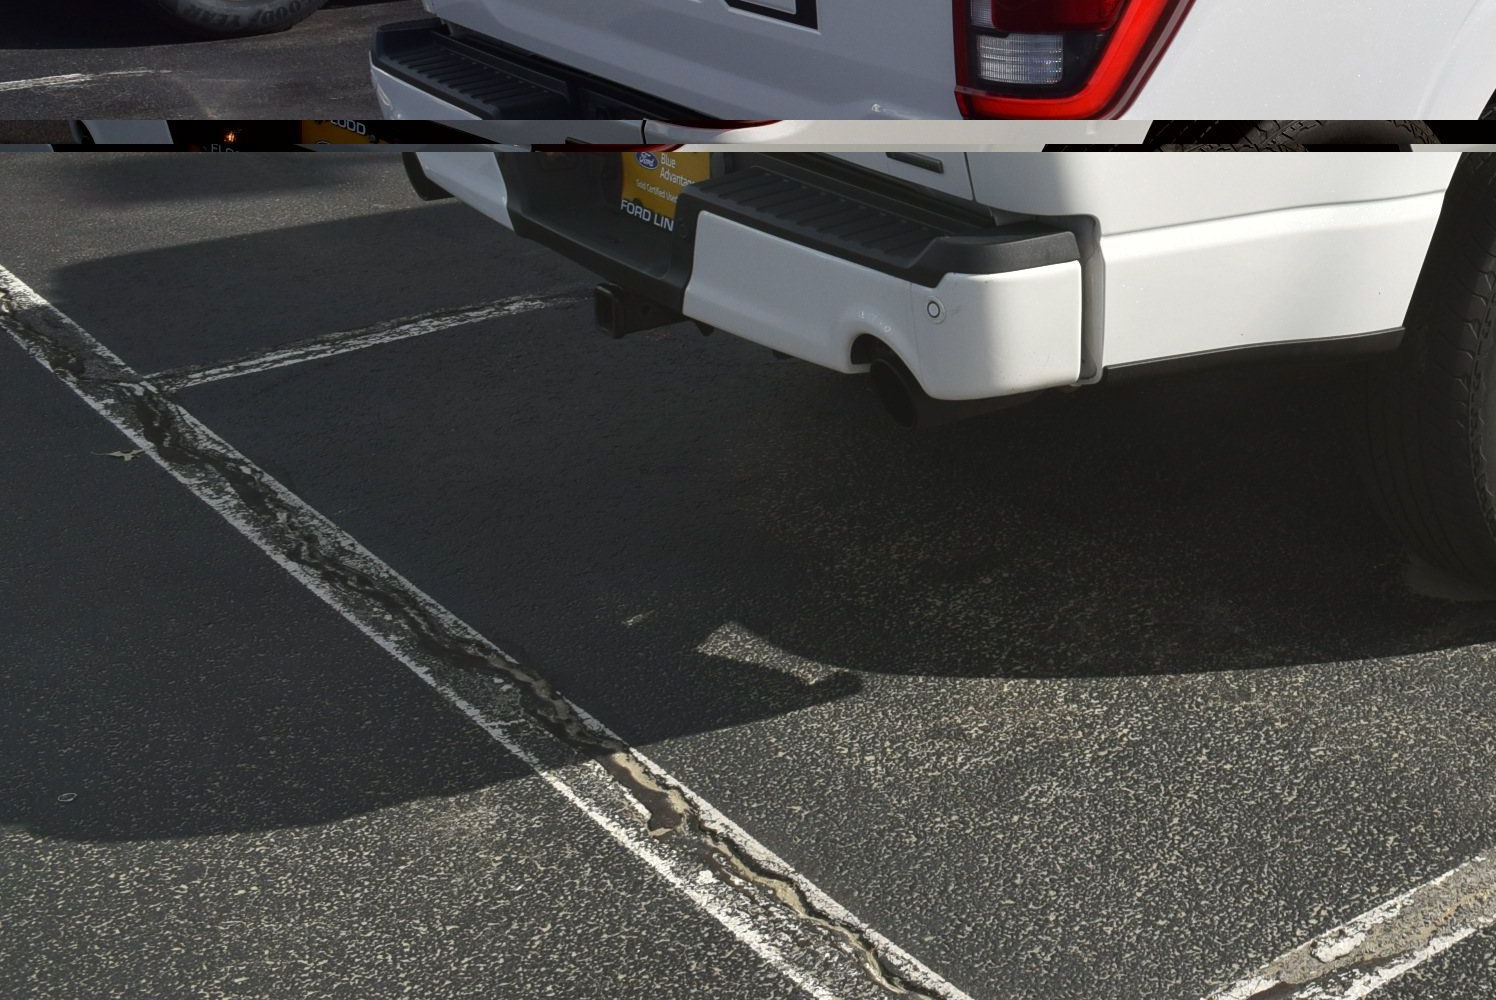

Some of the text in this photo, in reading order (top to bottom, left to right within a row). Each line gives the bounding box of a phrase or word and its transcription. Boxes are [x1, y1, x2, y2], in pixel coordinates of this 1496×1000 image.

[661, 152, 676, 168] Blue
[660, 167, 696, 187] Advanta
[620, 199, 652, 222] FORD
